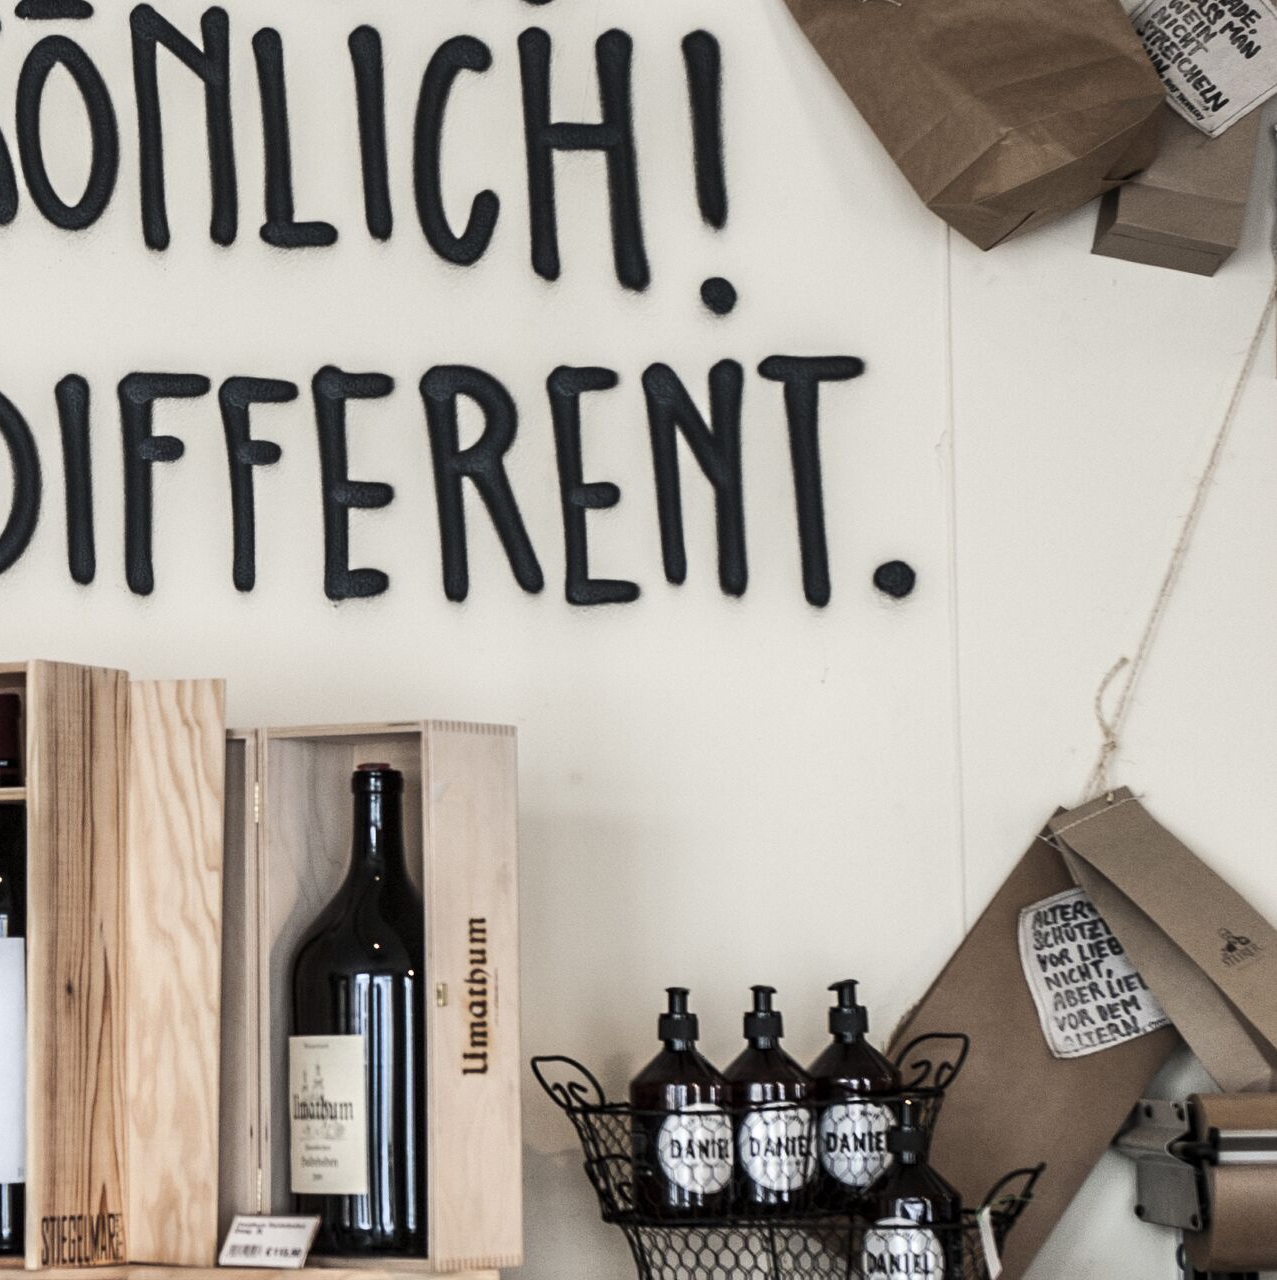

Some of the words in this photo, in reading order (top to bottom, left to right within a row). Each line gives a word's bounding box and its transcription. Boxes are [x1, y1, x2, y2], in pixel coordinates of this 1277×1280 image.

[1151, 6, 1209, 56] NICHT
[1219, 20, 1262, 59] MAN
[1136, 20, 1230, 112] STREICHELN
[1032, 900, 1089, 930] ALTER
[1035, 948, 1073, 973] VOR
[461, 917, 488, 1077] Umathum
[1053, 980, 1106, 1011] ABER
[1053, 1008, 1095, 1032] VOR
[1096, 994, 1142, 1022] DEM
[825, 1131, 886, 1154] DANIE
